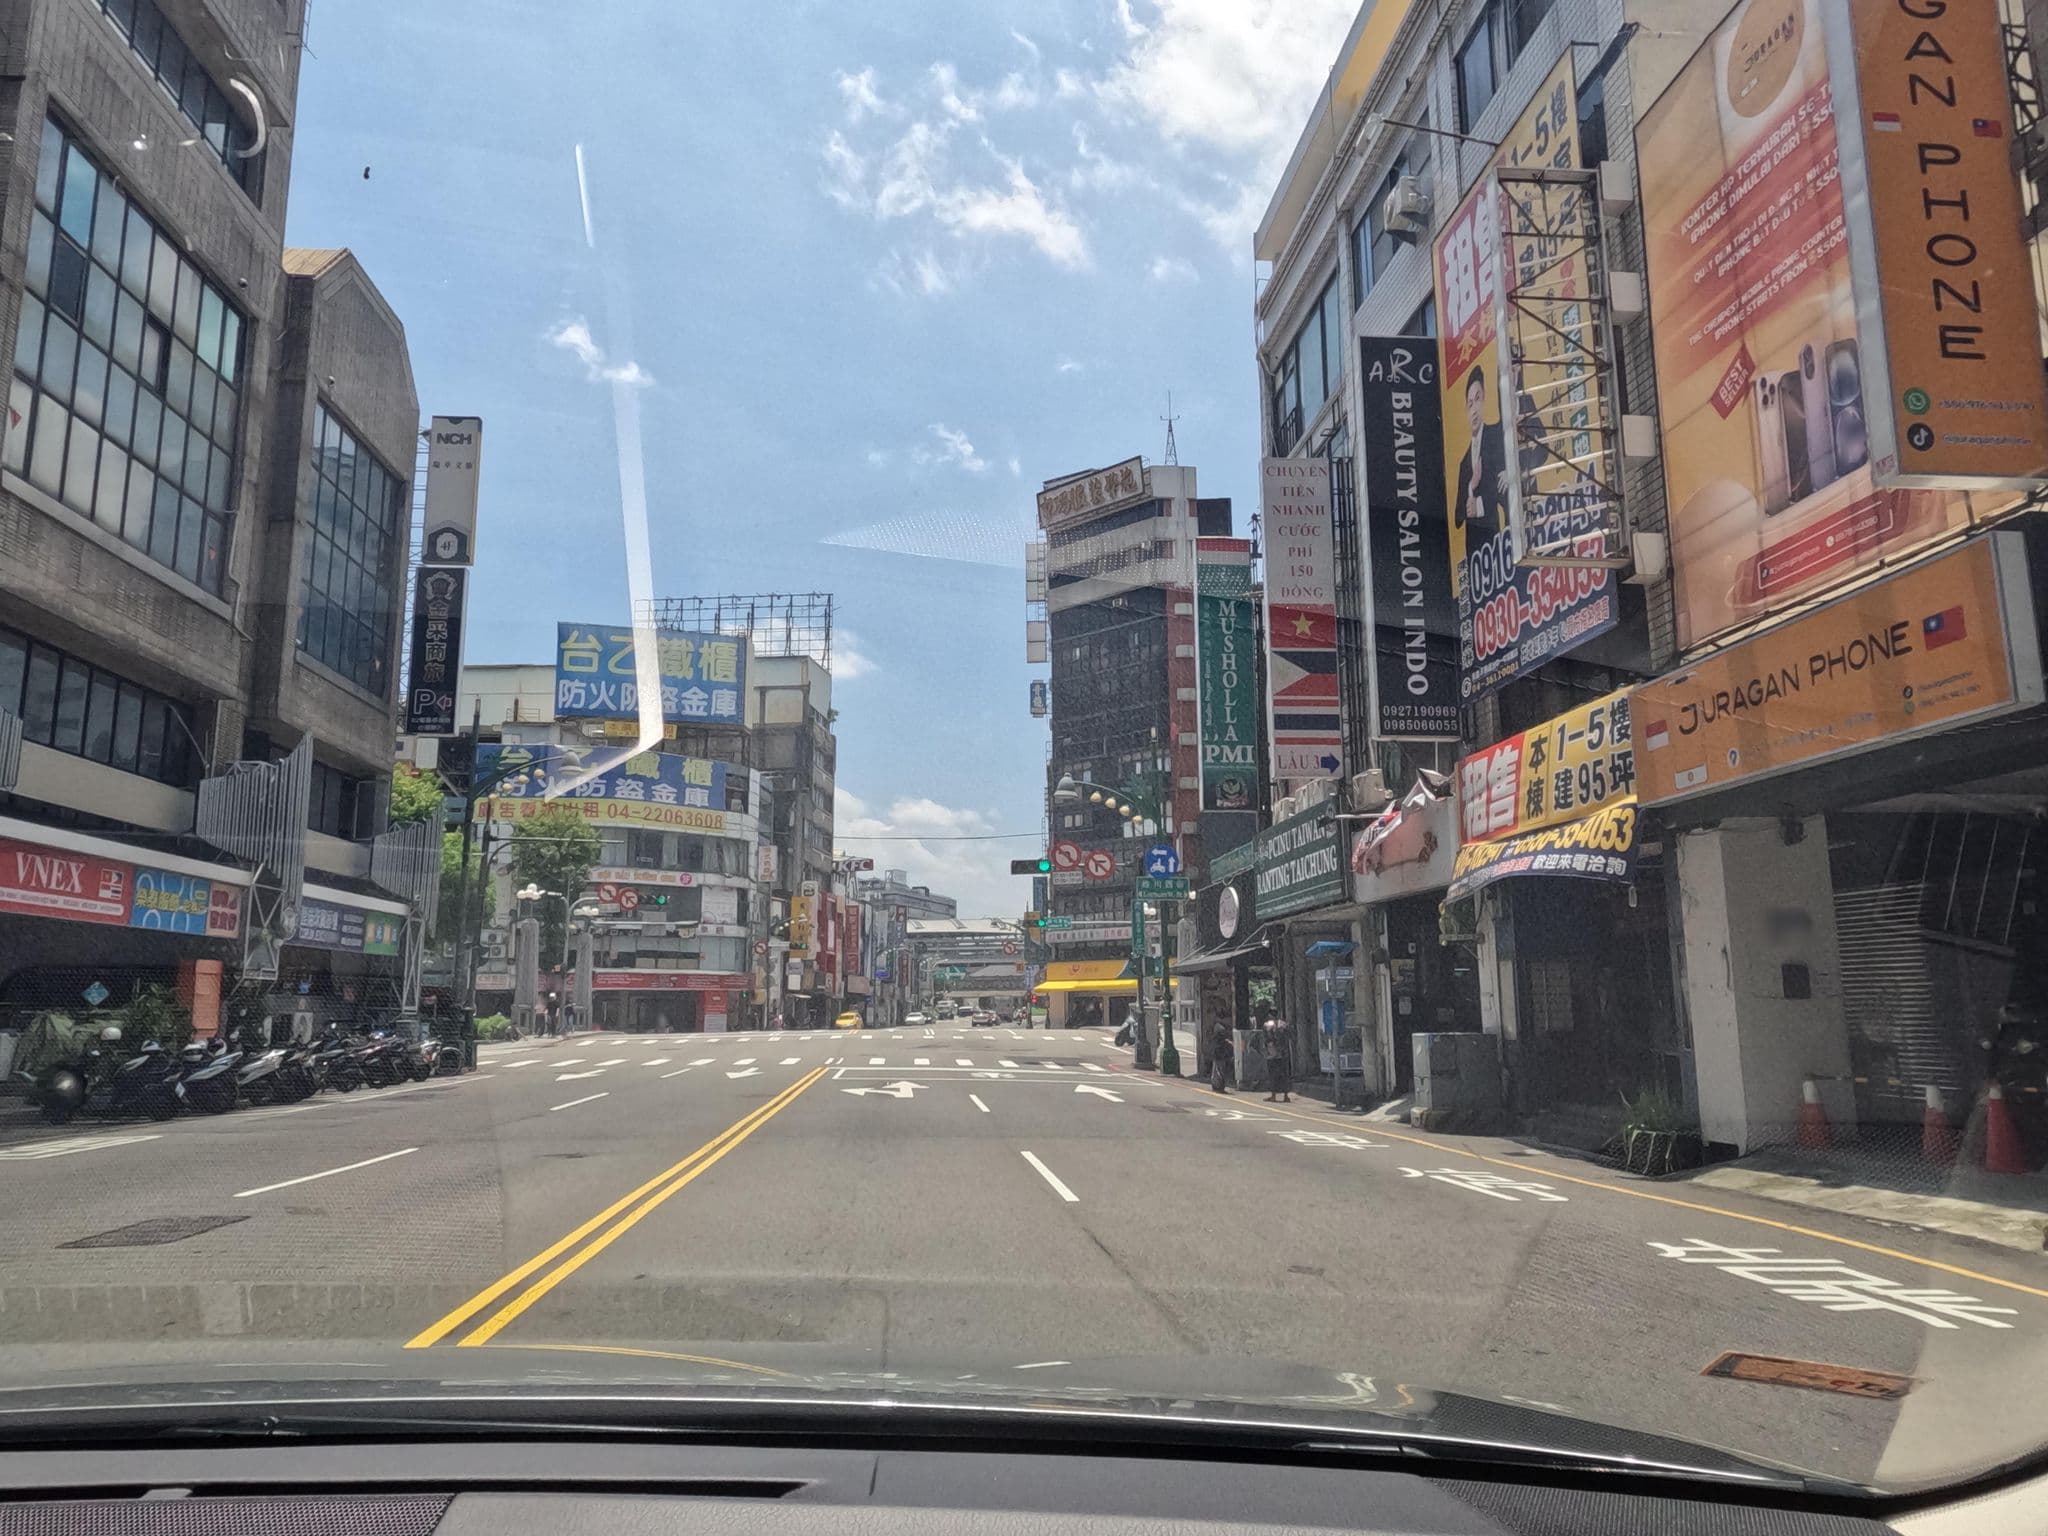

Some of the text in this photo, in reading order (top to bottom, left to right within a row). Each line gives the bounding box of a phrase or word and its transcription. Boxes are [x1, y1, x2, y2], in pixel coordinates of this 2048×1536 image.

[1690, 203, 1728, 244] IPHONE
[1800, 215, 1843, 254] COUNTER
[1917, 142, 1987, 361] PHONE
[1717, 357, 1744, 400] BEST
[436, 432, 472, 445] NCH
[1272, 504, 1326, 516] NHANH
[1391, 391, 1430, 696] BEAUTY SALON INDO
[1290, 565, 1314, 577] 150
[1217, 599, 1239, 742] MUSHOLLA
[1678, 662, 1801, 736] JURAGAN
[1808, 620, 1914, 688] PHONE
[413, 688, 437, 716] P
[1557, 696, 1632, 763] 1-5樓
[1204, 745, 1255, 763] PMI
[1460, 744, 1520, 843] 租售
[1526, 733, 1549, 820] 本棟
[1553, 750, 1636, 816] 建95坪
[606, 803, 723, 829] 04-22063608
[15, 851, 86, 894] VNEX
[838, 859, 873, 873] KFC
[1256, 865, 1291, 896] RANTING
[1289, 844, 1338, 885] TAICHUNG
